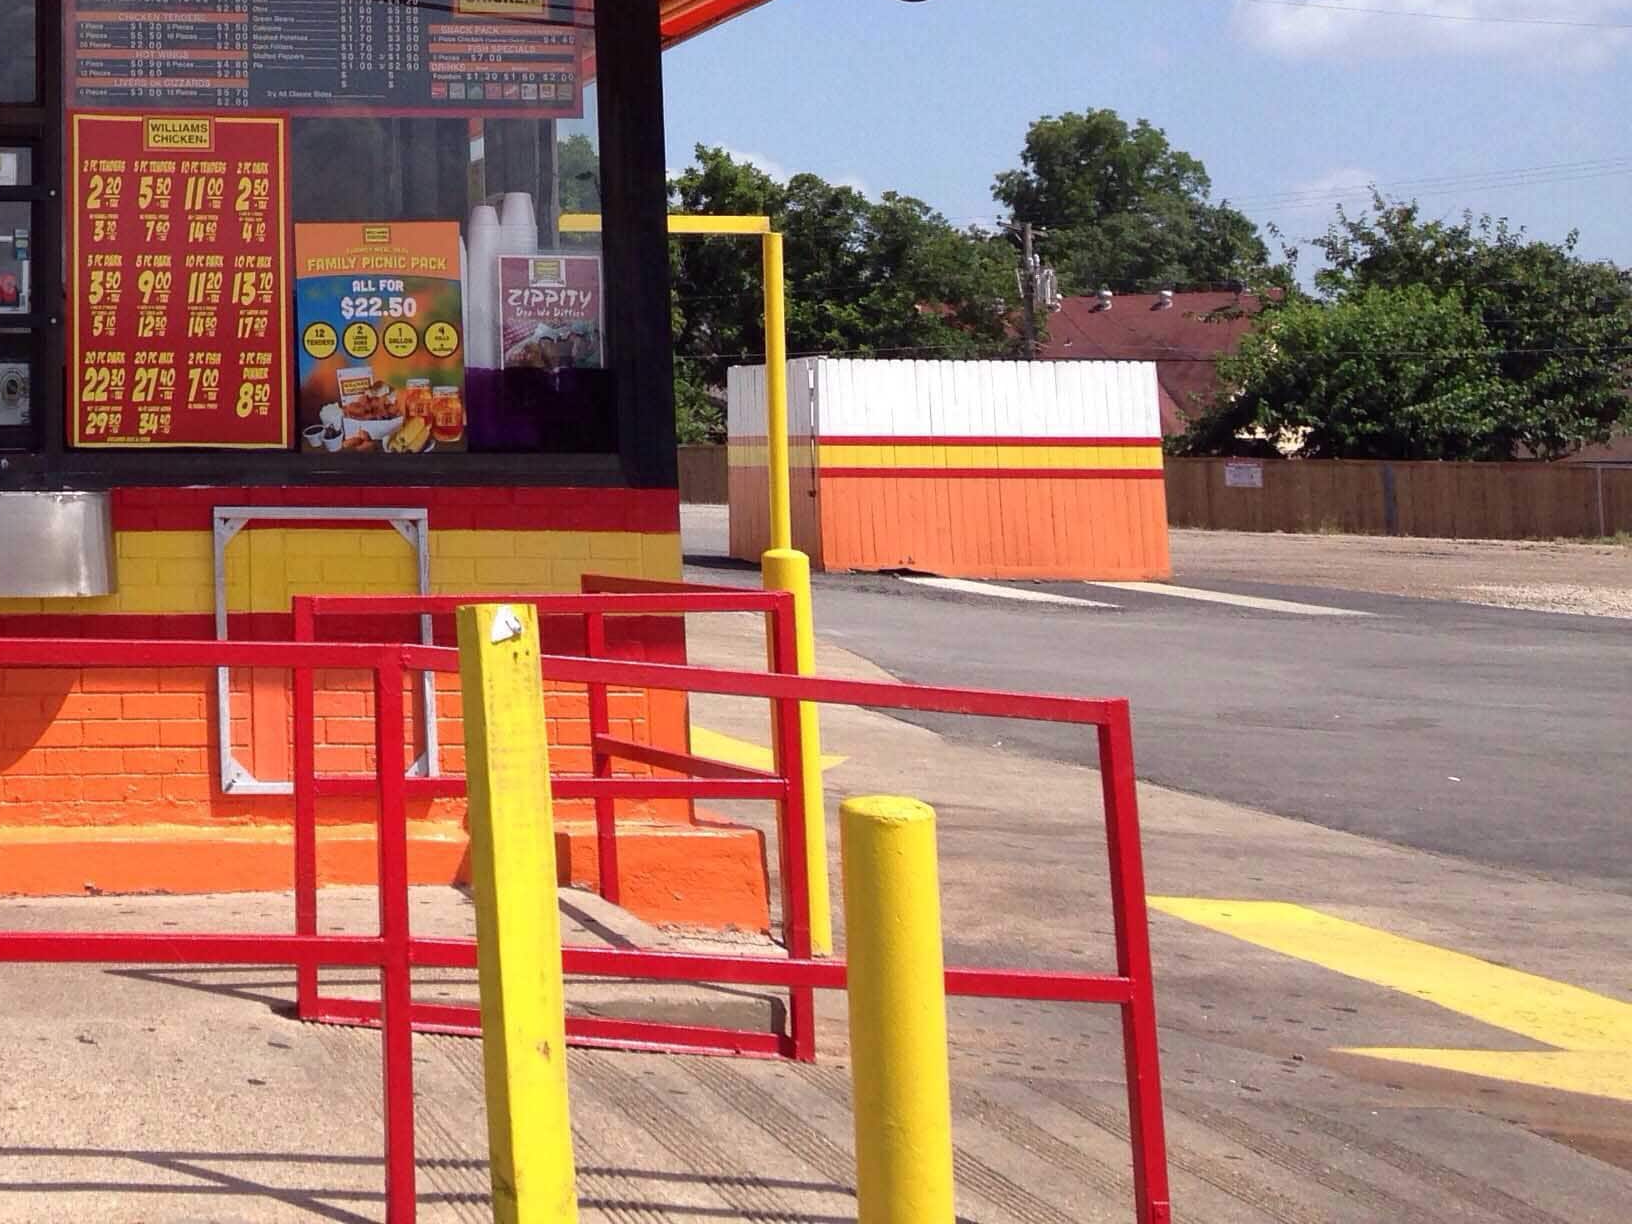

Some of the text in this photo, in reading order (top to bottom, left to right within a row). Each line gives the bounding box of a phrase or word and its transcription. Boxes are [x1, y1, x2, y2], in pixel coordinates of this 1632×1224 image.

[150, 123, 209, 133] WILLIAMS
[307, 256, 447, 272] FAMILY PICNIC PACK
[352, 279, 404, 292] ALL FOR
[507, 288, 592, 309] ZIPPITY
[340, 296, 417, 320] $22.50
[315, 328, 326, 338] 12
[356, 325, 364, 335] 2
